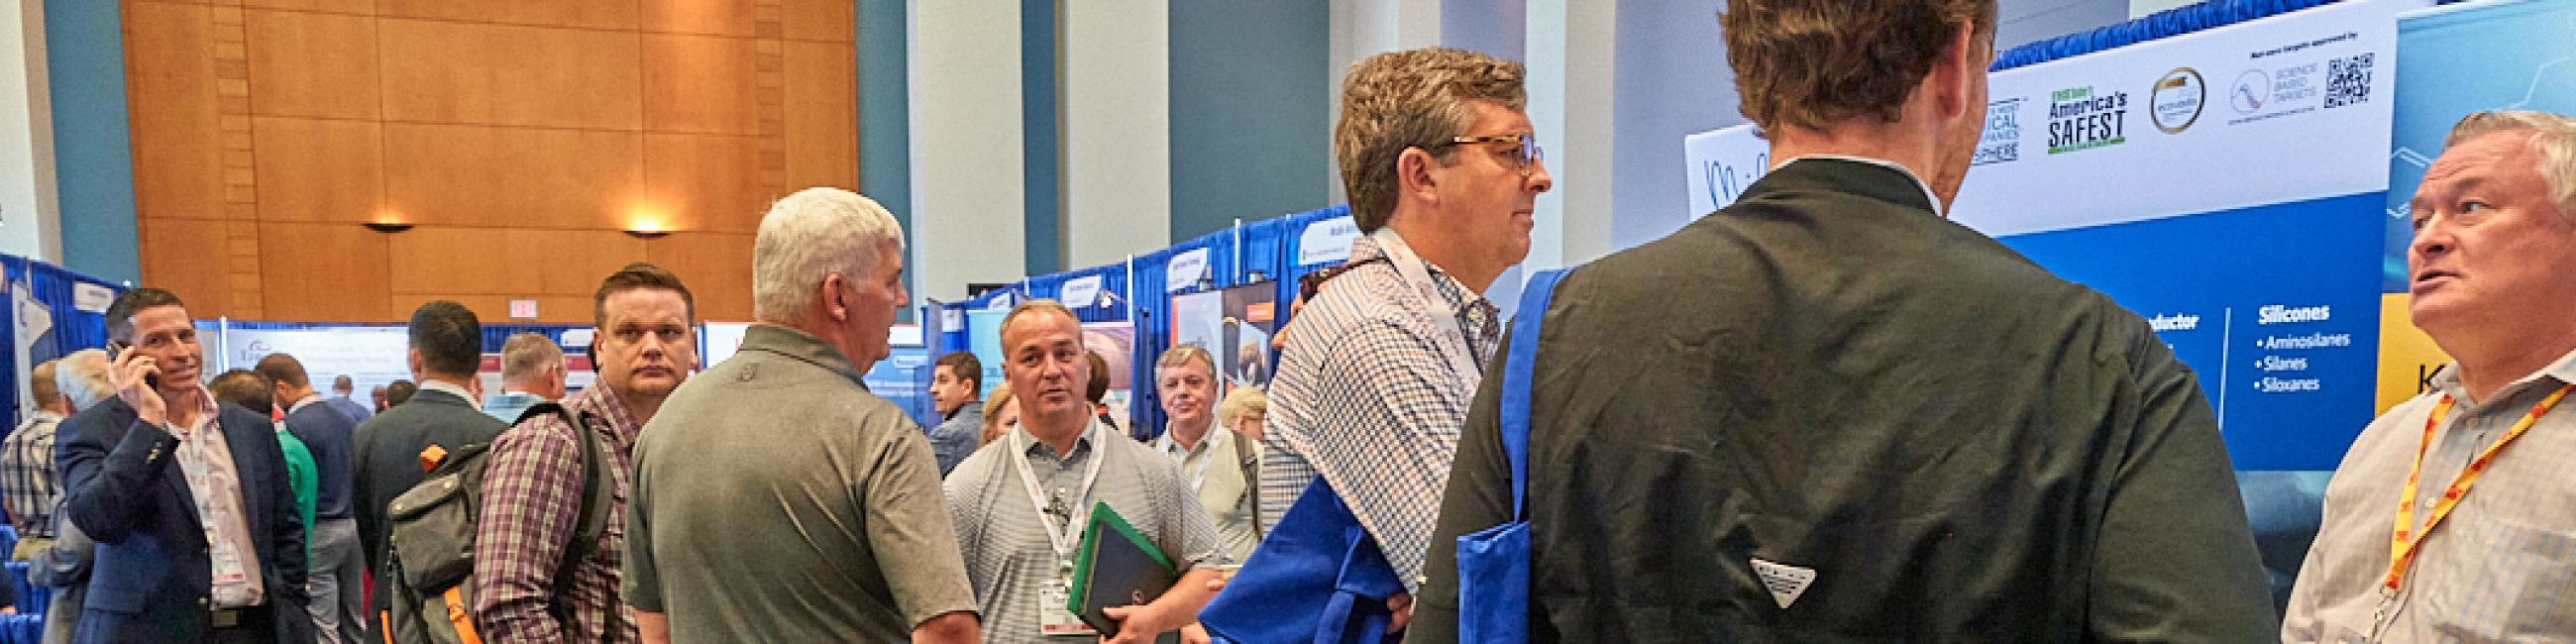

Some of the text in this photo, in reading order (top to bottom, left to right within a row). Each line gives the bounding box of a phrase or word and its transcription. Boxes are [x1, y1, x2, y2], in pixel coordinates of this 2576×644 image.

[2275, 62, 2317, 79] SCIENCE
[2273, 86, 2316, 103] TARGETS
[2049, 90, 2128, 119] America's
[1986, 112, 2020, 131] ICAL
[2047, 110, 2126, 148] SAFEST
[2148, 311, 2200, 332] ductor
[2258, 304, 2330, 325] Silicones
[2266, 331, 2352, 349] Aminosilanes
[2263, 355, 2308, 372] Silanes
[2261, 376, 2320, 392] Siloxanes
